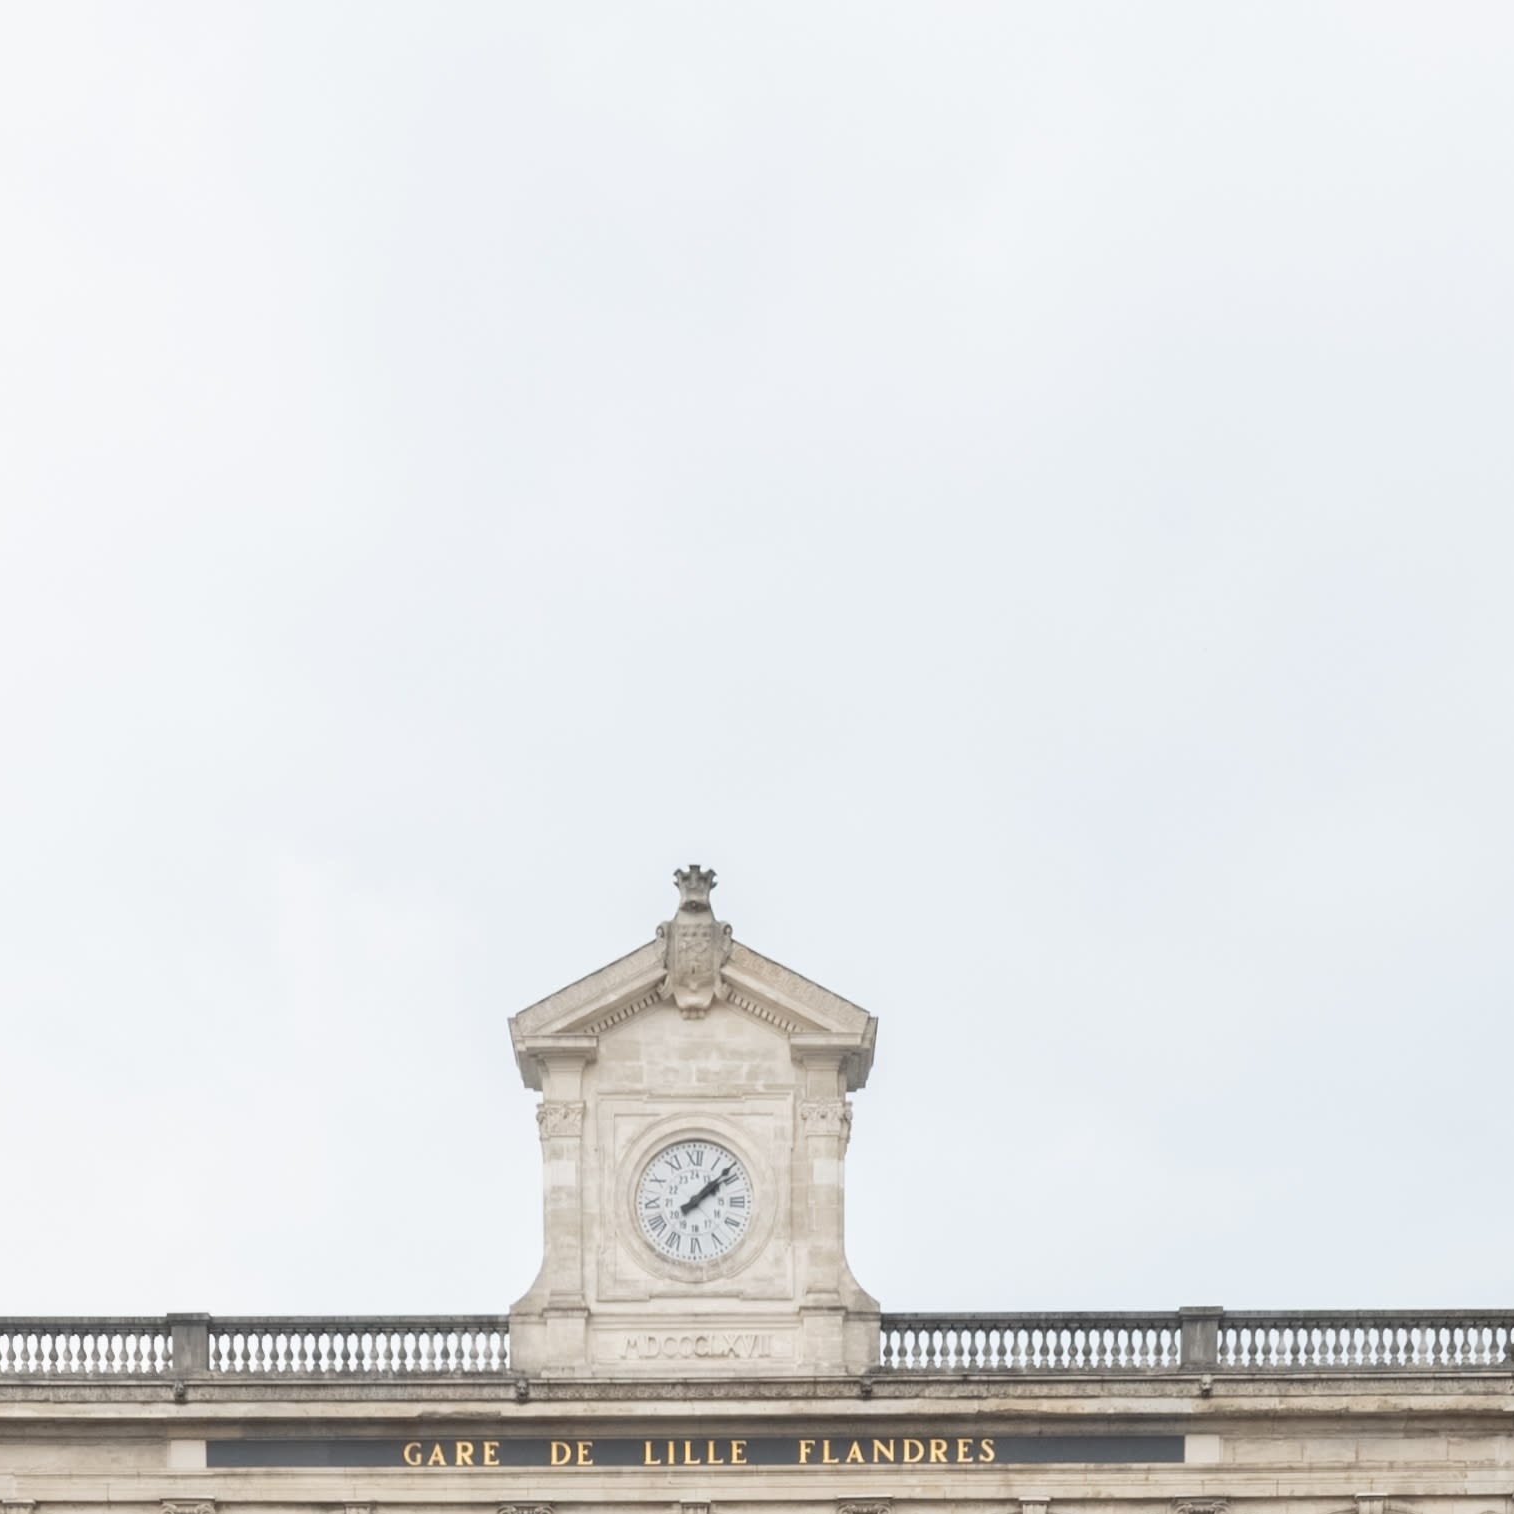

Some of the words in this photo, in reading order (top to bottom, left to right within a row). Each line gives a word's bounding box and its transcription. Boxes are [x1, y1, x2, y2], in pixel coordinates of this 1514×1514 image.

[403, 1442, 501, 1466] GARE
[550, 1442, 594, 1465] DE
[643, 1440, 748, 1465] LILLE
[798, 1439, 997, 1463] FLANDRES
